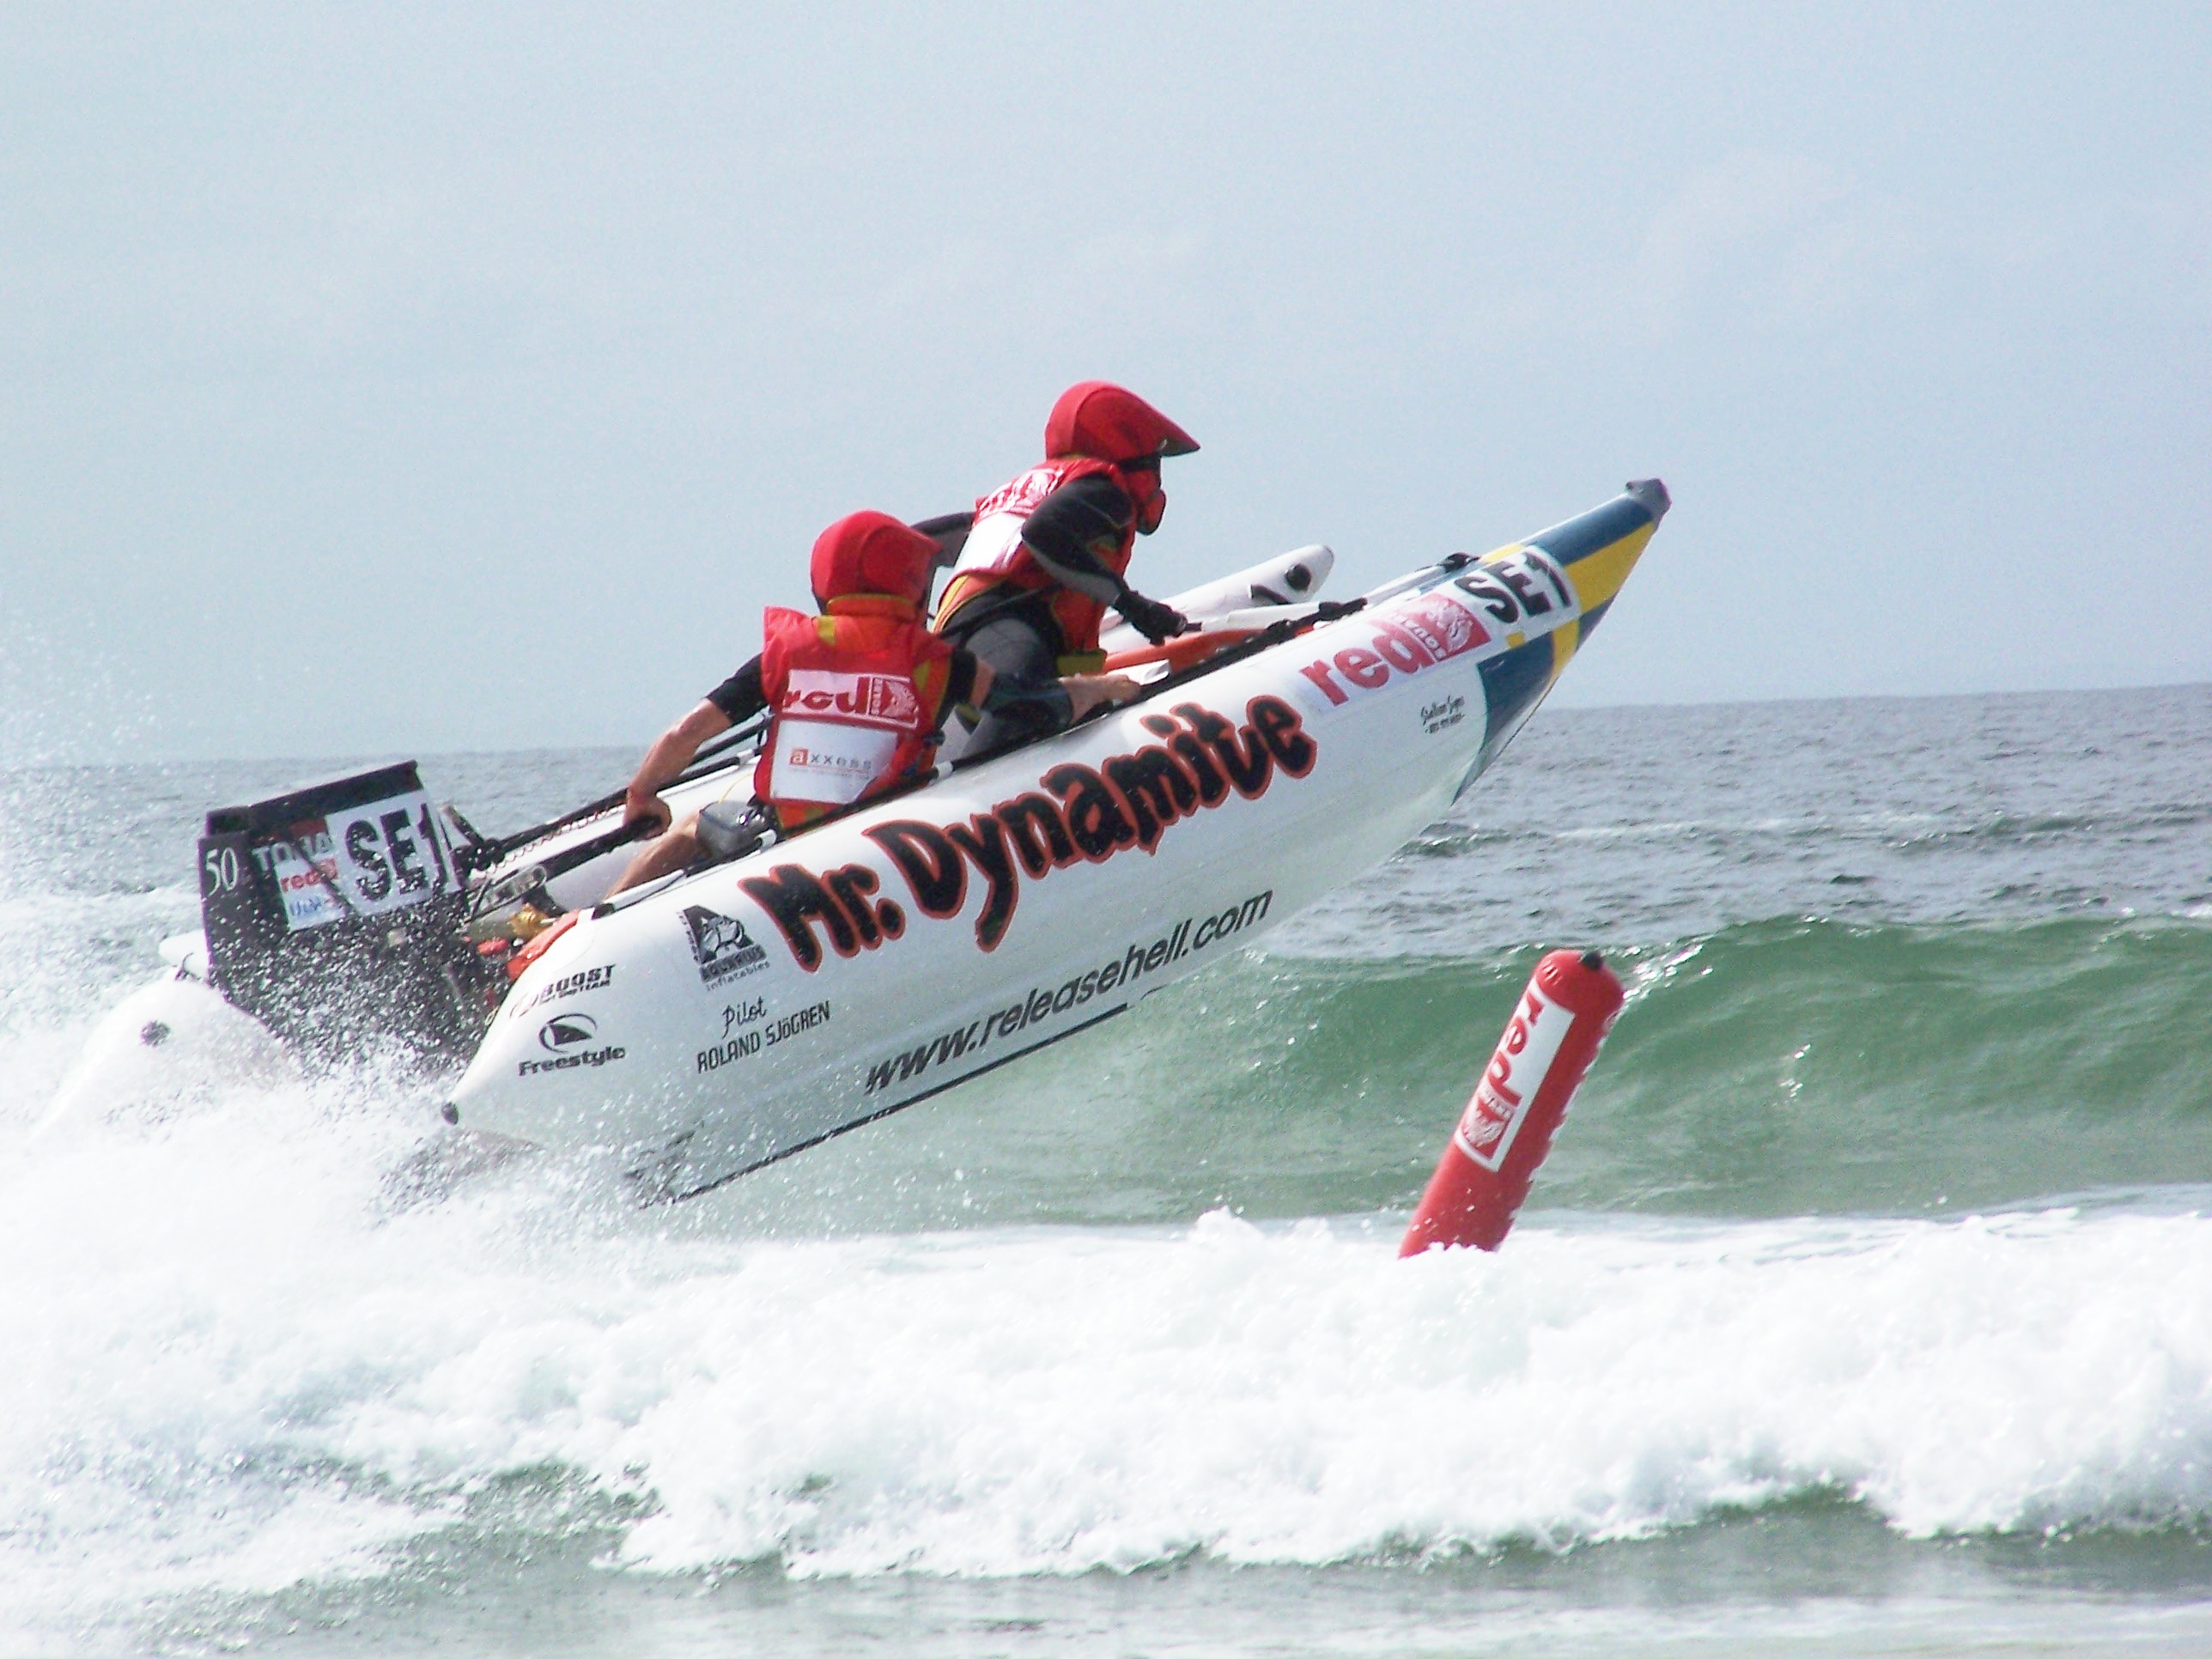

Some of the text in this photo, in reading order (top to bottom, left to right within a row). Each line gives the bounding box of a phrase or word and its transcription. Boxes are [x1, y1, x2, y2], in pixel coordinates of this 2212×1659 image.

[1454, 551, 1572, 623] SE1
[783, 677, 871, 714] red
[1299, 619, 1436, 707] red
[345, 803, 448, 902] SE1
[738, 695, 1319, 973] Mr. Dynamite
[203, 846, 238, 897] 50
[721, 995, 768, 1039] Pilot
[864, 890, 1273, 1097] www.releasehell.com
[518, 1046, 626, 1076] Freestyle
[696, 1030, 761, 1074] ROLAND
[1487, 991, 1546, 1107] red
